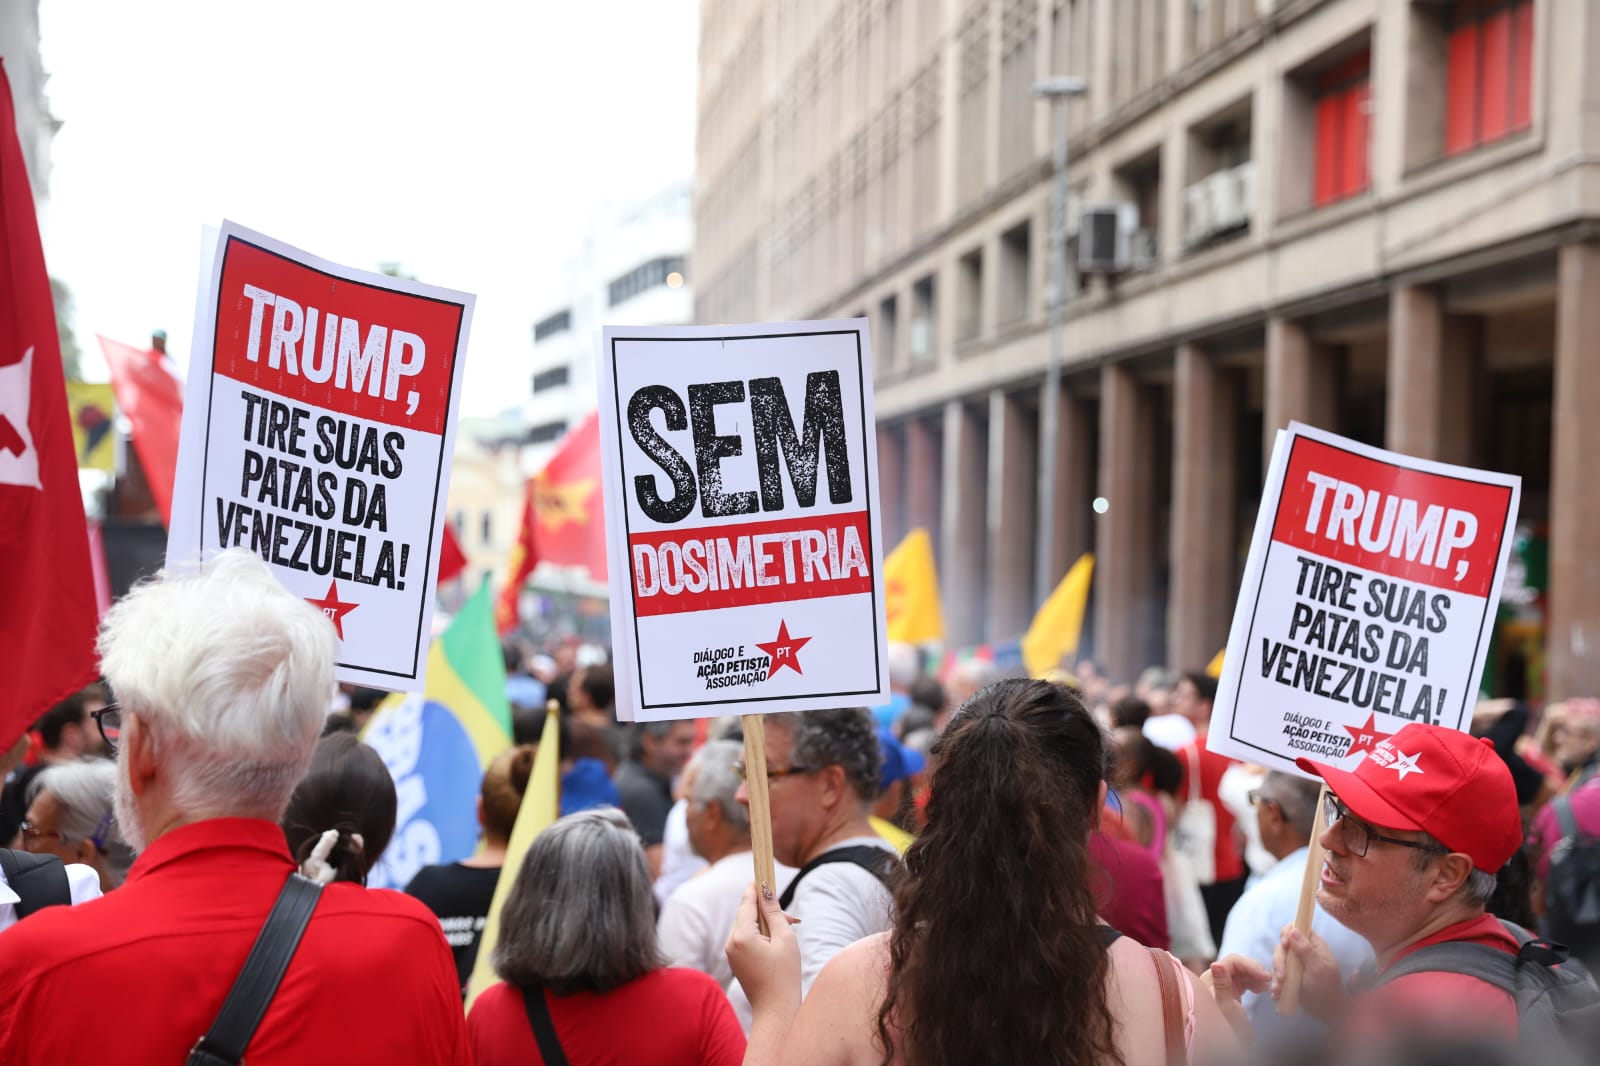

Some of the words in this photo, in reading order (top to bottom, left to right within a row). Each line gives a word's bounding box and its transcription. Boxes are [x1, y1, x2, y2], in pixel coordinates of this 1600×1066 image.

[242, 283, 426, 416] TRUMP,
[241, 391, 311, 458] TIRE
[313, 415, 405, 480] SUAS
[627, 370, 853, 523] SEM
[240, 449, 338, 521] PATAS
[342, 478, 387, 532] DA
[1304, 471, 1478, 582] TRUMP,
[216, 496, 410, 591] VENEZUELA!
[632, 525, 869, 598] DOSIMETRIA
[1296, 555, 1363, 612] TIRE
[1363, 578, 1451, 634] SUAS
[693, 647, 734, 664] DIÁLOGO
[738, 645, 744, 656] E
[697, 660, 725, 680] AÇÃO
[726, 655, 770, 674] PETISTA
[776, 646, 791, 659] PT
[1288, 602, 1384, 664] PATAS
[1385, 630, 1429, 677] DA
[706, 669, 766, 690] ASSOCIAÇÃO
[1260, 638, 1448, 726] VENEZUELA!
[1283, 711, 1323, 729] DIÁLOGO
[1324, 721, 1332, 731] E
[1283, 725, 1310, 739] AÇÃO
[1310, 732, 1352, 748] PETISTA
[1288, 739, 1345, 758] ASSOCIAÇÃO
[1358, 734, 1374, 746] PT
